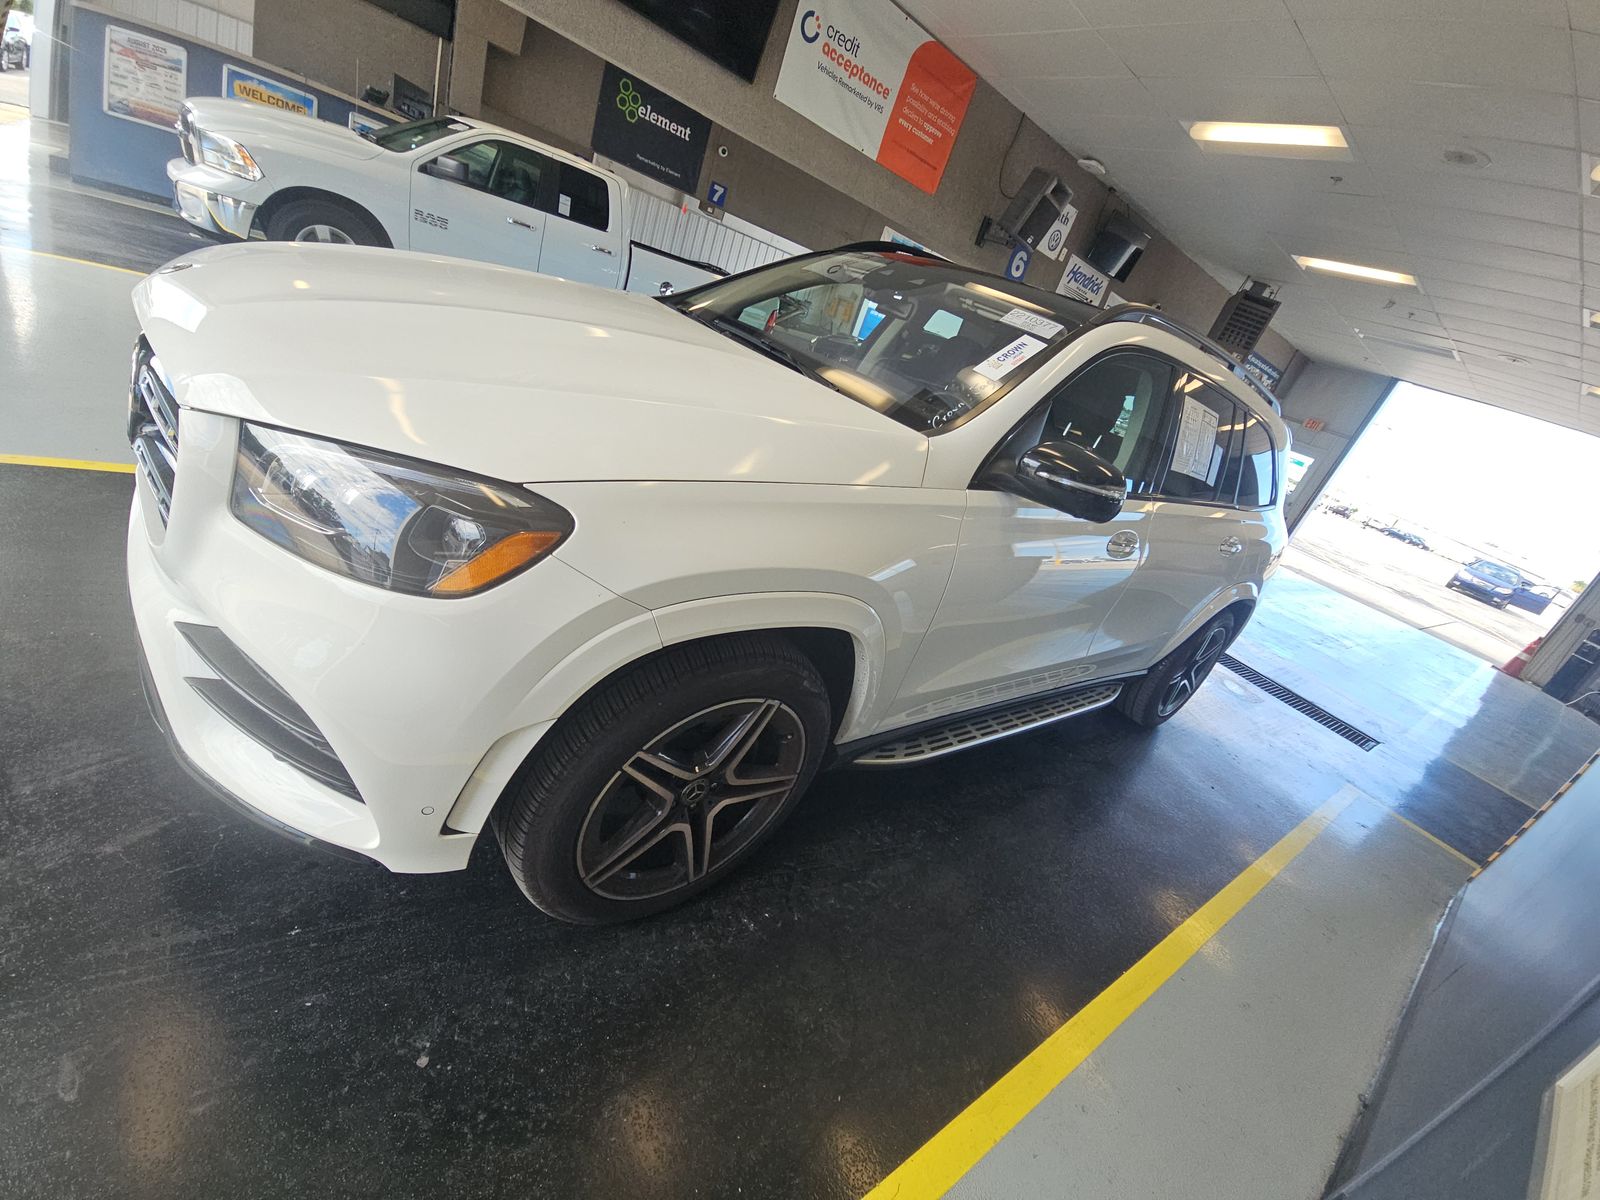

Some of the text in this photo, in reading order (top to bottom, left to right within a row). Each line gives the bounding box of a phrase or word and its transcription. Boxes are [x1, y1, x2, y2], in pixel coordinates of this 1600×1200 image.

[826, 24, 861, 58] credit
[817, 60, 884, 114] Vehicles Remarketed by VRS
[822, 41, 891, 100] acceptance
[637, 104, 692, 142] element
[712, 184, 725, 202] 7
[1011, 250, 1028, 278] 6
[1066, 263, 1104, 296] Hendrick
[1009, 310, 1059, 330] 2210377
[996, 341, 1029, 362] CROWN
